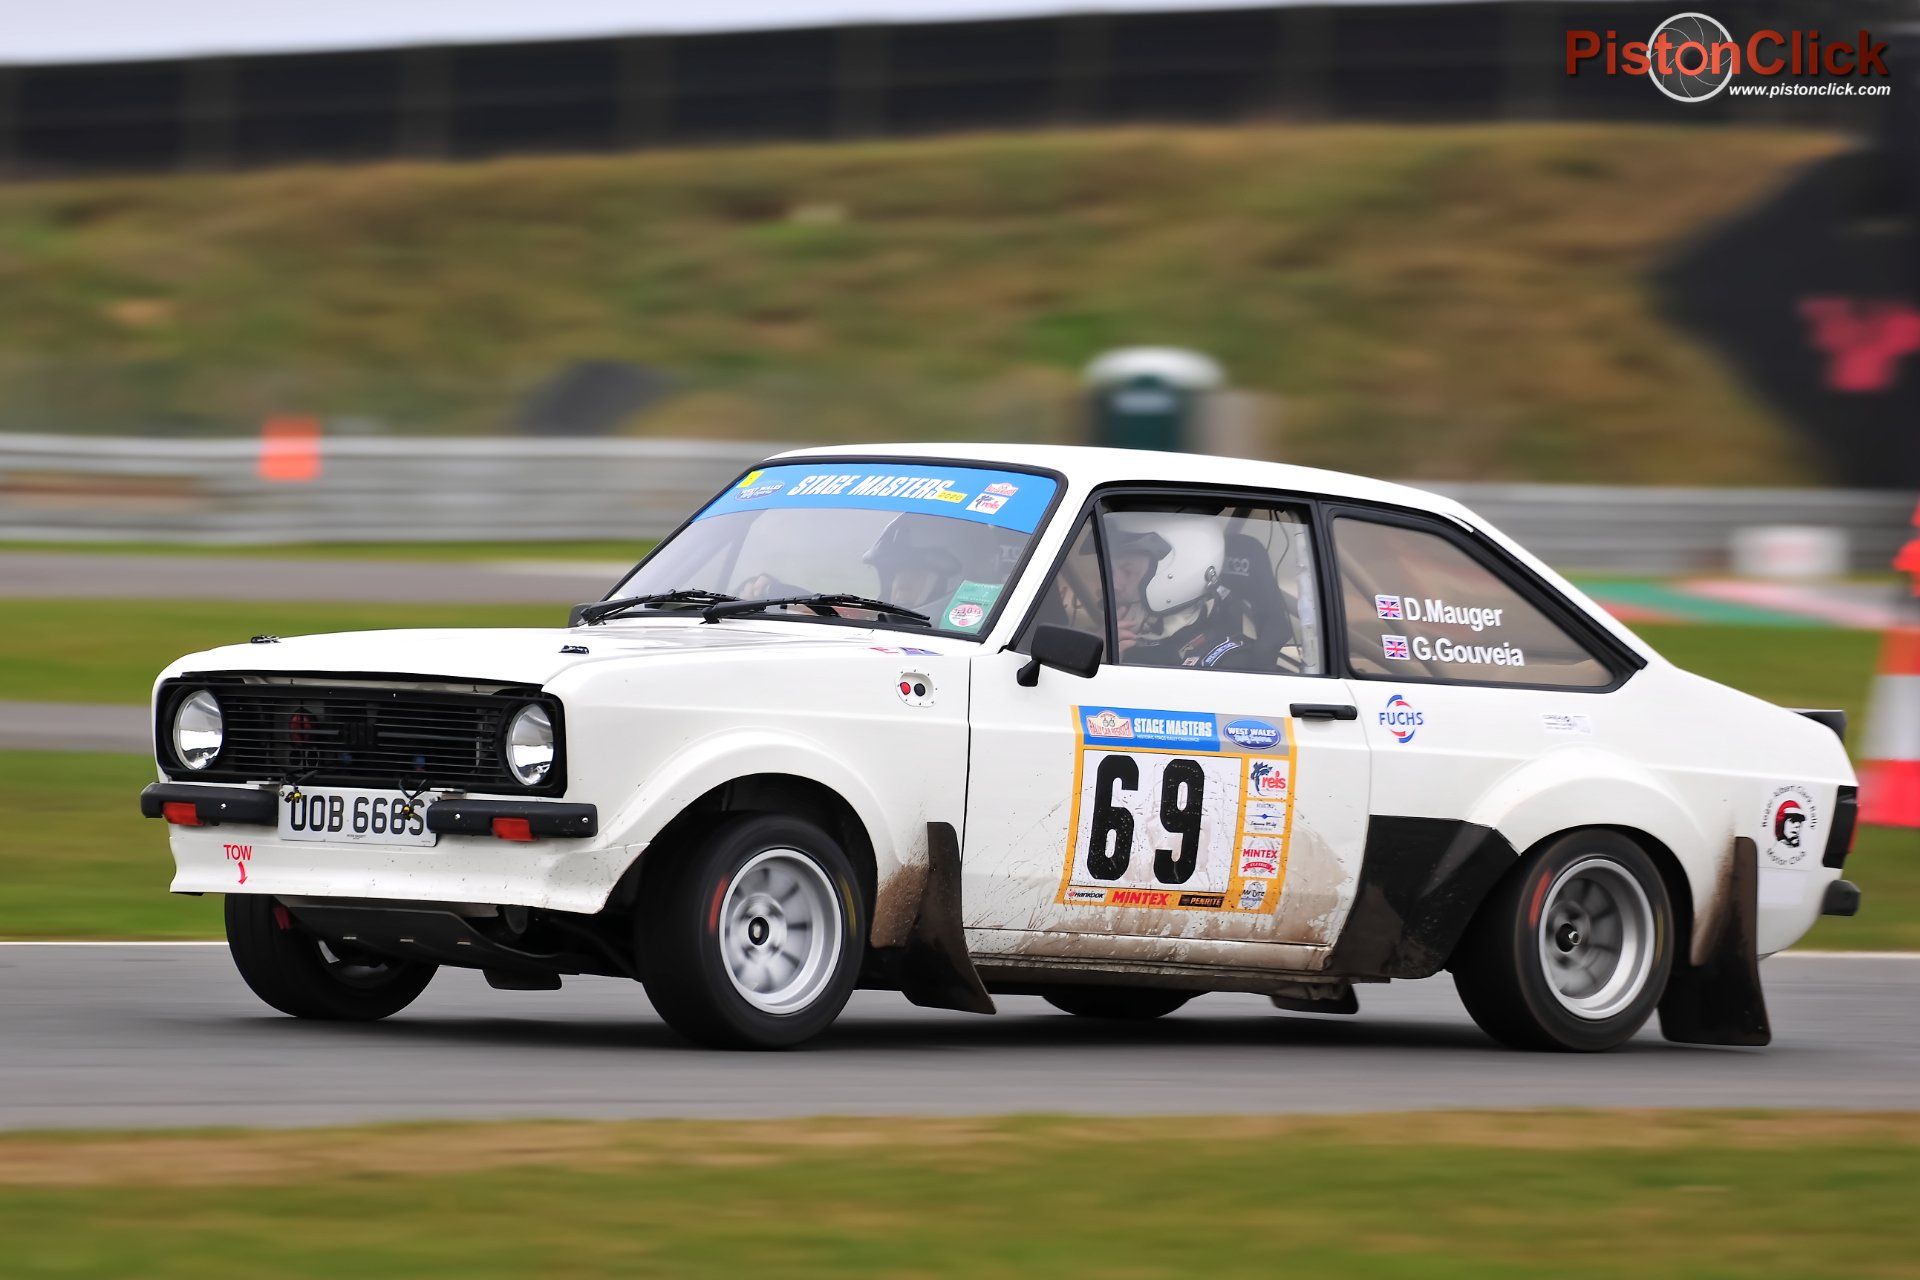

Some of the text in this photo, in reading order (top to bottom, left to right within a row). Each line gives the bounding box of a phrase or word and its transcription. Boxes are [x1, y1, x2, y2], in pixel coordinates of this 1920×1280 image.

[787, 474, 956, 500] STAGE MASTERS
[1404, 597, 1503, 631] D.Mauger
[1412, 637, 1525, 667] G.Gouveia
[1133, 718, 1165, 734] STAGE
[1166, 719, 1213, 737] MASTERS
[1379, 711, 1424, 726] FUCHS
[1227, 727, 1276, 737] WEST WALES
[1262, 771, 1286, 789] reis
[290, 795, 344, 833] UOB
[1087, 754, 1205, 884] 69
[223, 845, 252, 861] TOW
[1242, 848, 1278, 859] MINTEX
[1112, 890, 1169, 906] MINTEX
[1190, 897, 1223, 906] PENRITE
